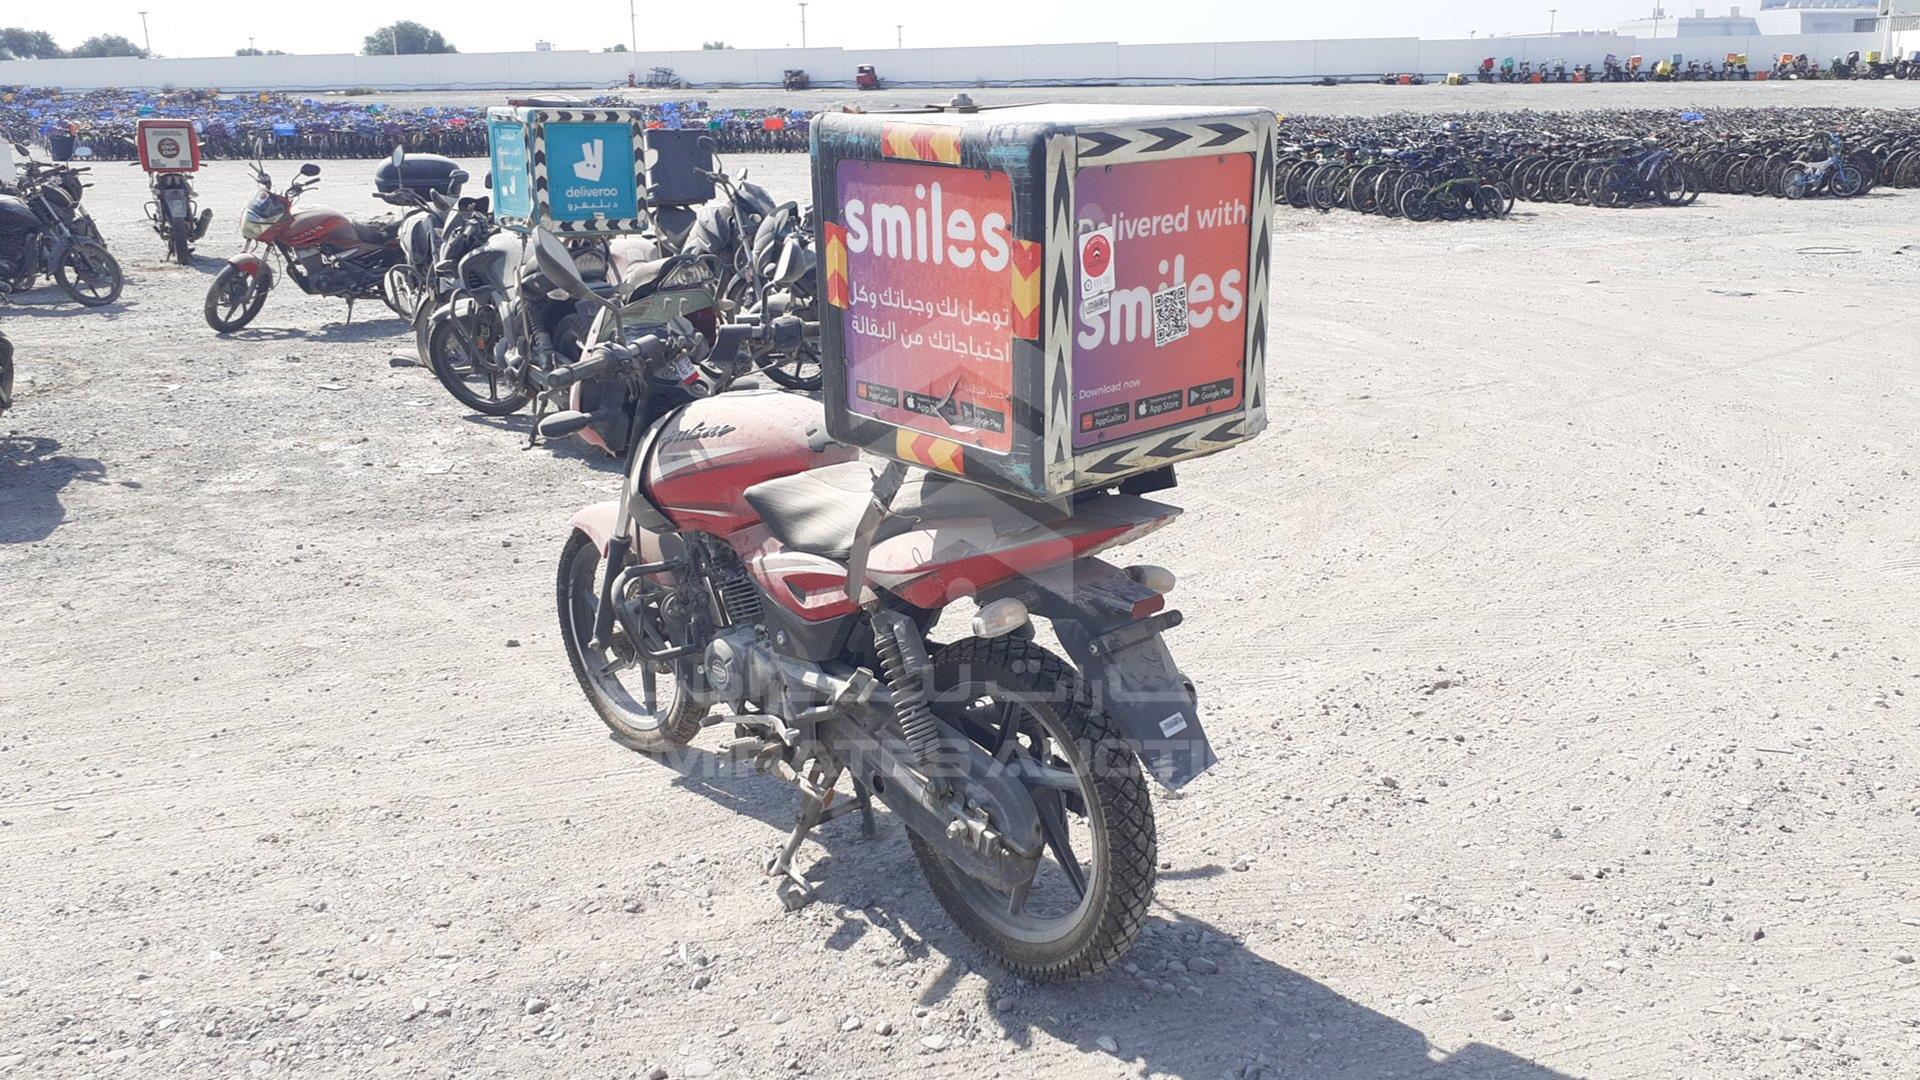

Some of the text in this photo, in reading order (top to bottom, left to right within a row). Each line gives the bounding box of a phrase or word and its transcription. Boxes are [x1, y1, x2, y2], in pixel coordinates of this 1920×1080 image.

[565, 186, 618, 198] deliveroo
[844, 181, 1010, 273] smiles
[1078, 198, 1247, 242] Dlivered with
[848, 281, 877, 308] وكل
[880, 288, 934, 319] وجباتك
[936, 296, 959, 318] لك
[1077, 253, 1243, 351] smes
[851, 314, 1010, 363] احتياجاتك من البقالة
[1079, 377, 1141, 400] Download now
[1149, 400, 1180, 415] App Store
